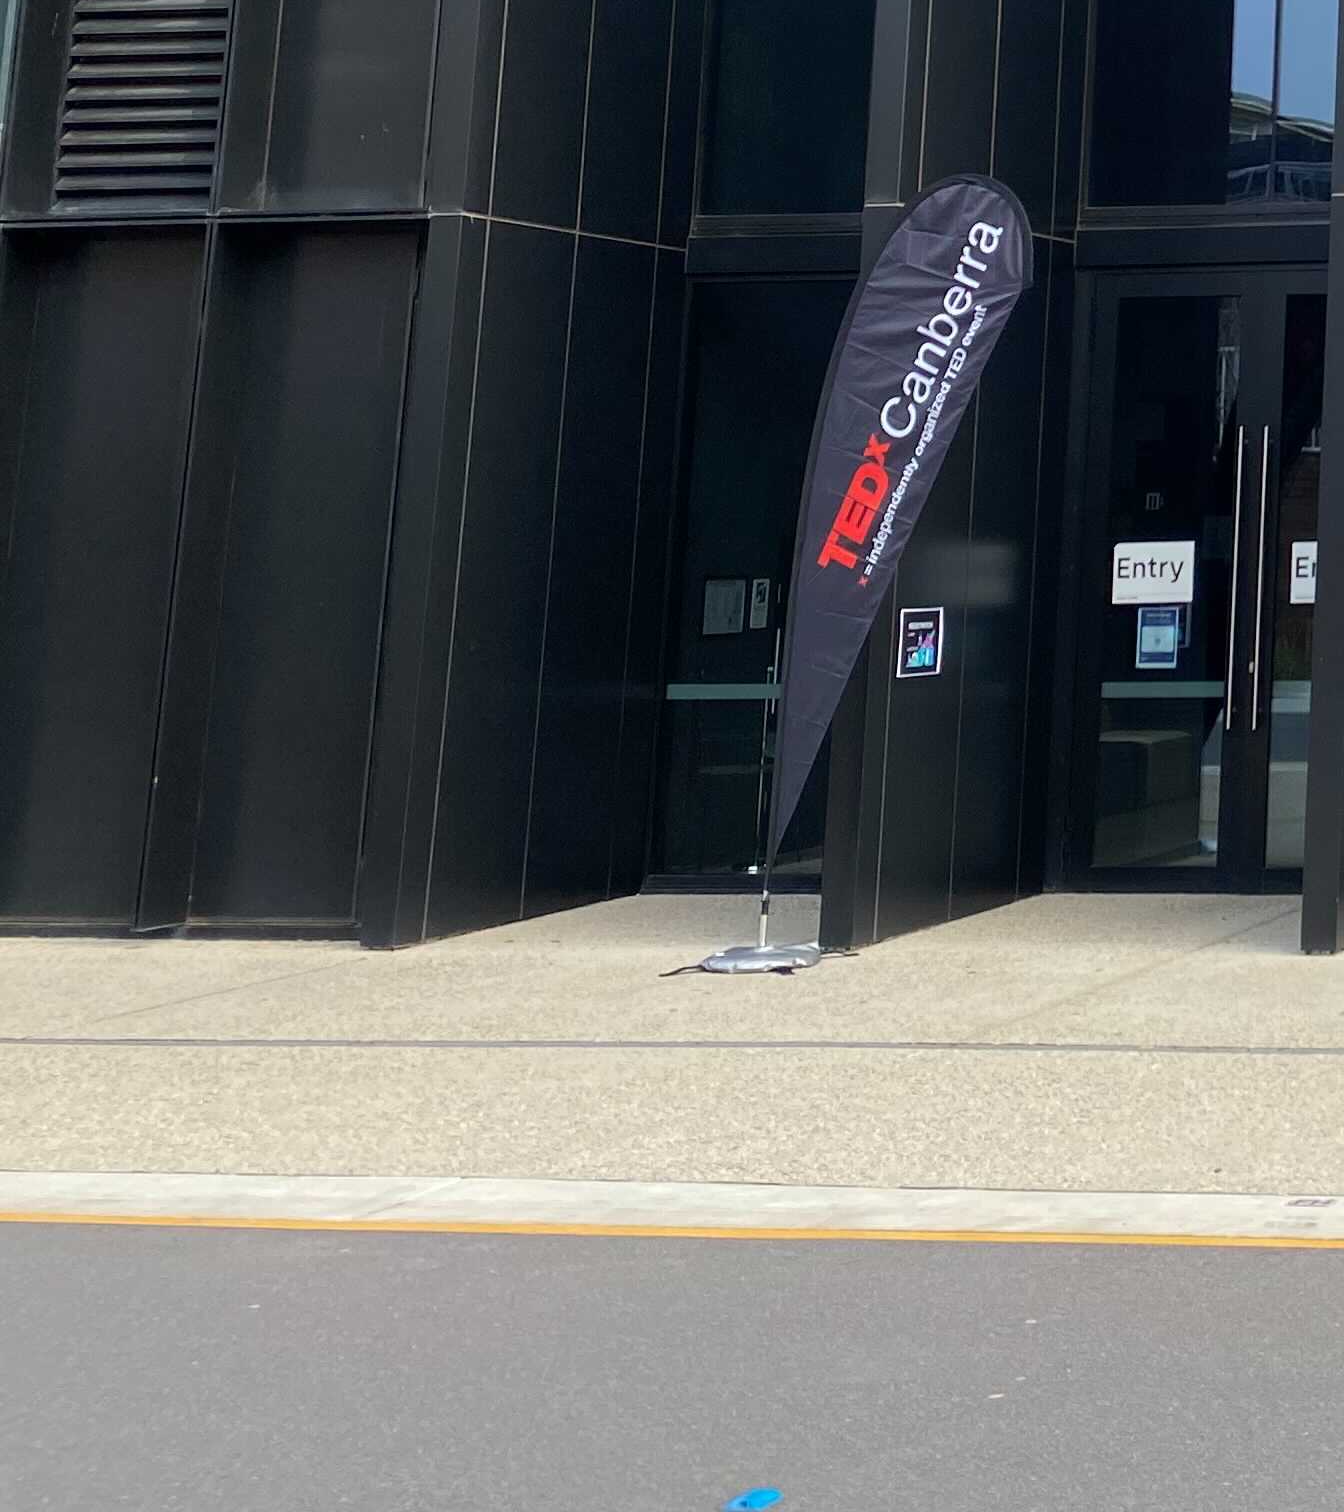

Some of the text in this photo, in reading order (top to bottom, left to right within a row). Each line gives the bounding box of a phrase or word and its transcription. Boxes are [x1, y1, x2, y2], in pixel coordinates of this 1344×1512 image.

[914, 380, 952, 458] organized
[946, 346, 968, 381] TED
[961, 303, 988, 348] event
[1117, 557, 1184, 583] Entry
